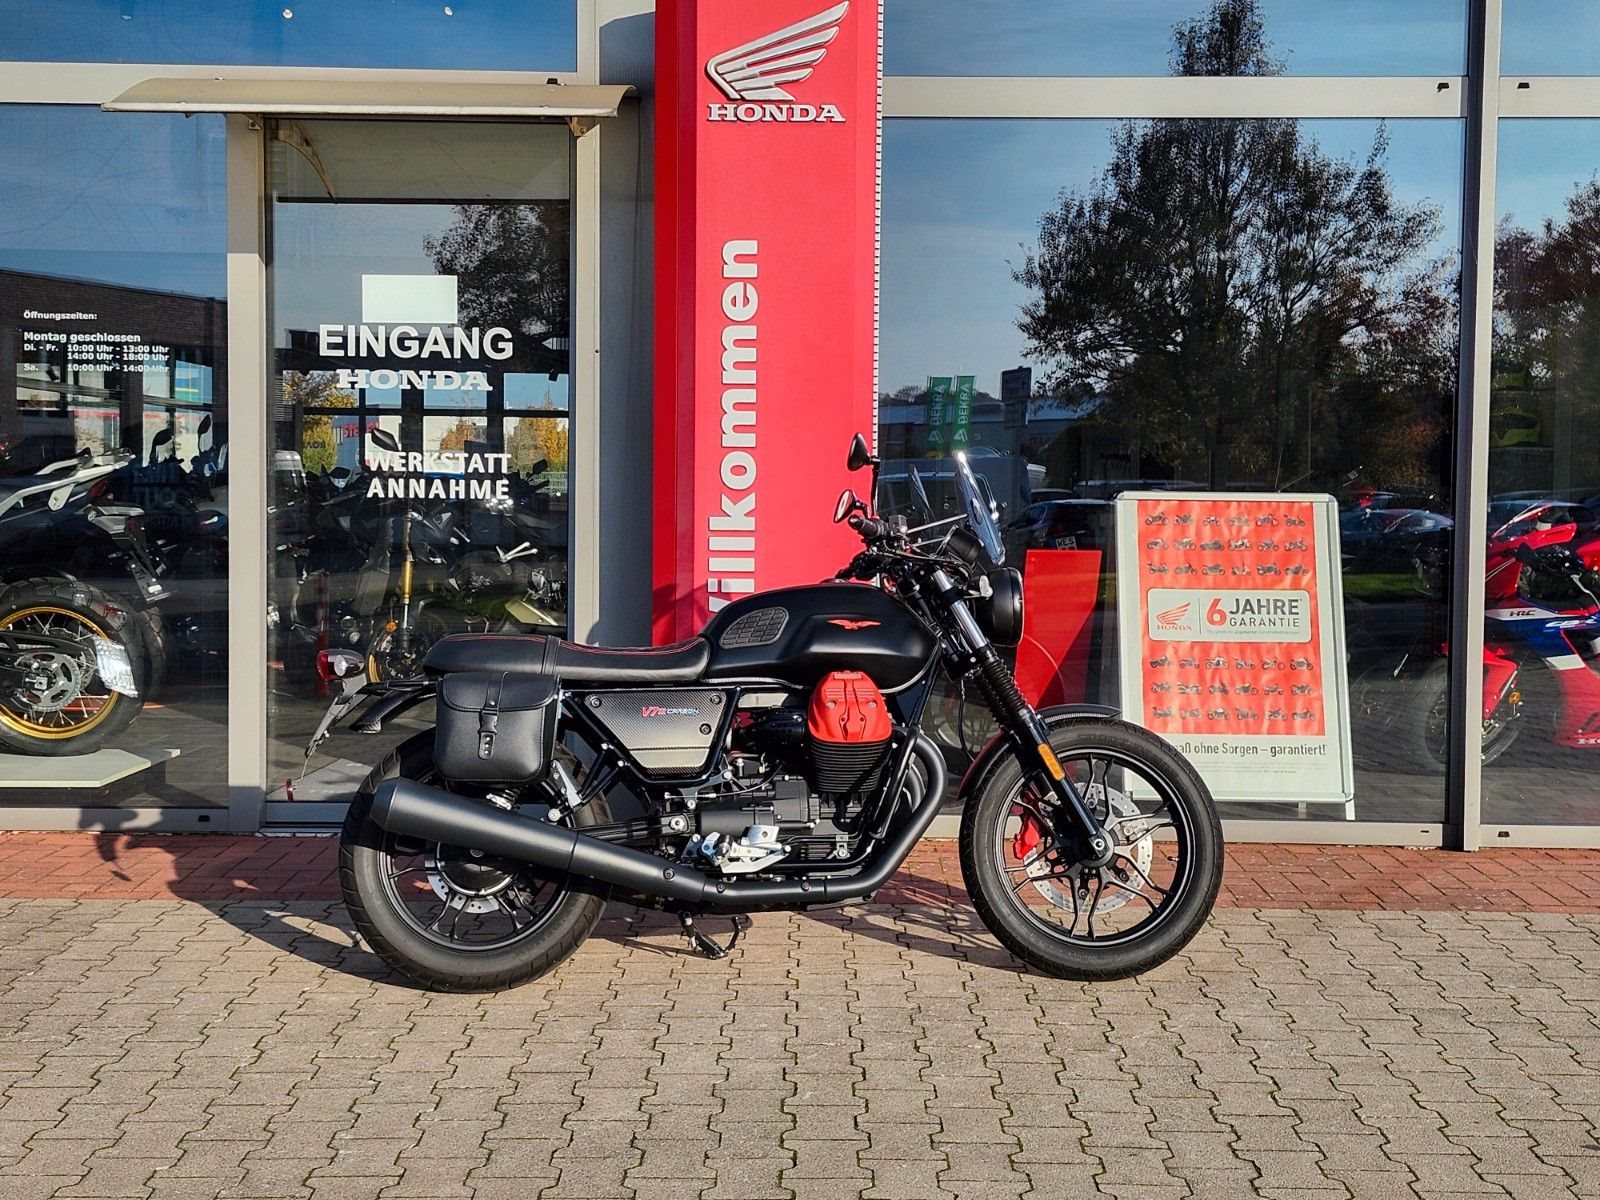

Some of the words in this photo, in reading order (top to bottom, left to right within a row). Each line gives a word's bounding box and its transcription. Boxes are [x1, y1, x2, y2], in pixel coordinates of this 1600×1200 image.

[707, 103, 846, 122] HONDA
[23, 309, 98, 321] Öffnungszeiten:
[24, 331, 68, 343] Montag
[69, 332, 141, 343] geschlossen
[318, 324, 514, 361] EINGANG
[23, 344, 37, 352] Di.
[46, 344, 59, 352] Fr.
[67, 344, 94, 353] 10:00
[96, 344, 114, 353] Uhr
[122, 345, 150, 353] 13:00
[152, 345, 170, 353] Uhr
[67, 352, 94, 361] 14:00
[96, 352, 114, 361] Uhr
[122, 353, 150, 361] 18:00
[152, 353, 170, 361] Uhr
[23, 363, 39, 372] Sa.
[67, 363, 94, 372] 10:00
[96, 363, 114, 372] Uhr
[122, 364, 150, 373] 14:00
[152, 364, 170, 373] Uhr
[335, 368, 493, 391] HONDA
[930, 384, 947, 426] DEKRA
[957, 383, 970, 424] DEKRA
[708, 239, 759, 613] illkommen
[368, 452, 512, 475] WERKSTATT
[367, 477, 510, 500] ANNAHME
[1206, 597, 1227, 627] 6
[1229, 598, 1300, 616] JAHRE
[1156, 624, 1193, 632] HONDA
[1229, 617, 1300, 628] GARANTIE
[1194, 743, 1219, 755] ohne
[1222, 743, 1258, 758] Sorgen
